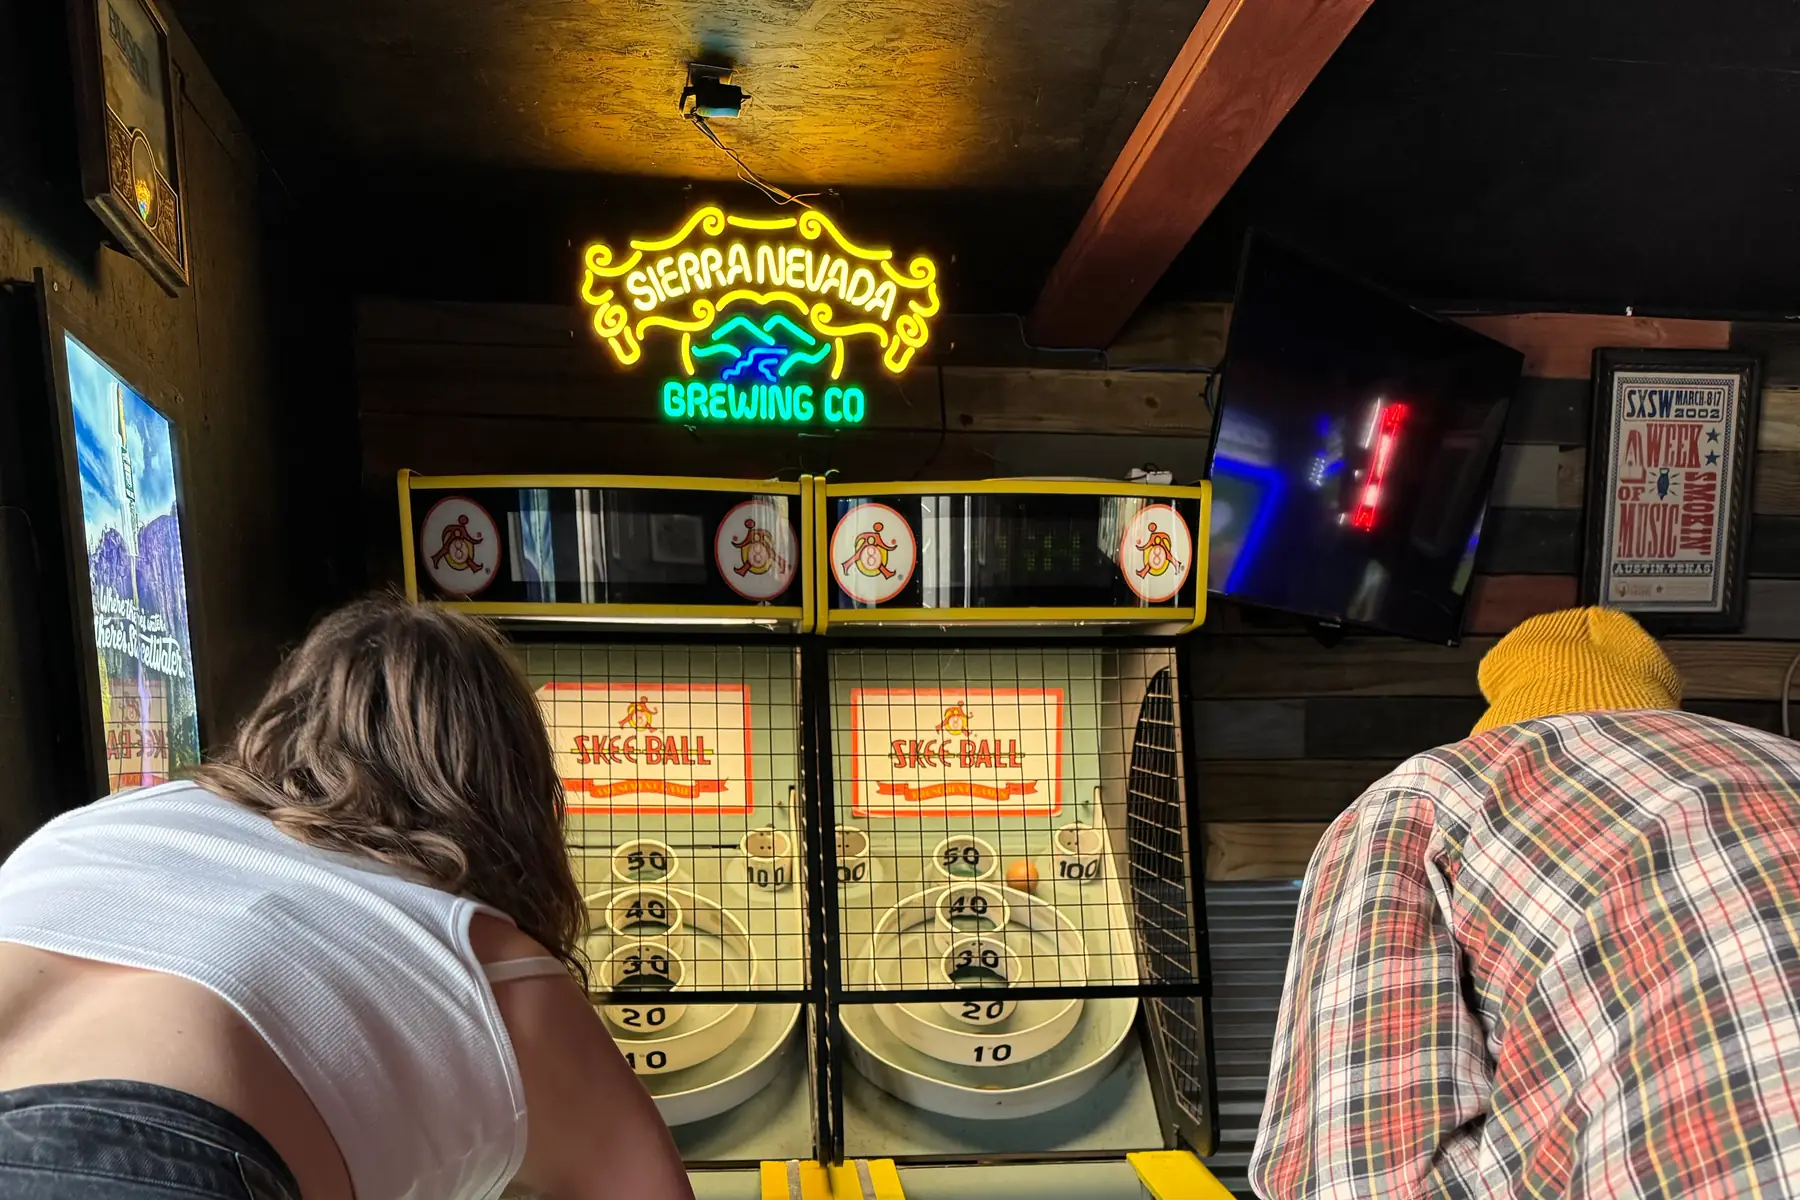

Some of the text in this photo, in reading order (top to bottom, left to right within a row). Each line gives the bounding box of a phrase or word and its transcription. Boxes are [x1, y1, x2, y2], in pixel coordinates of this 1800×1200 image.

[626, 243, 898, 322] SIERRA NEVADA
[663, 381, 865, 423] BREWING CO
[1626, 389, 1675, 418] SXSW
[1674, 390, 1704, 406] MARCH
[1674, 408, 1720, 419] 2002
[1646, 423, 1704, 468] WEEK
[1617, 486, 1645, 501] OF
[1679, 471, 1718, 556] SMOKIN'
[1616, 503, 1680, 558] MUSIC
[573, 734, 712, 766] SKEE BALL
[890, 738, 1023, 769] SKEE BALL
[627, 851, 668, 871] 50
[942, 846, 980, 866] 50
[746, 865, 785, 888] 100
[1058, 859, 1099, 880] 100
[625, 899, 667, 919] 40
[949, 895, 988, 915] 40
[622, 954, 669, 975] 30
[955, 949, 1000, 970] 30
[621, 1006, 666, 1027] 20
[961, 1000, 1004, 1020] 20
[624, 1050, 668, 1070] 10
[972, 1043, 1013, 1063] 10
